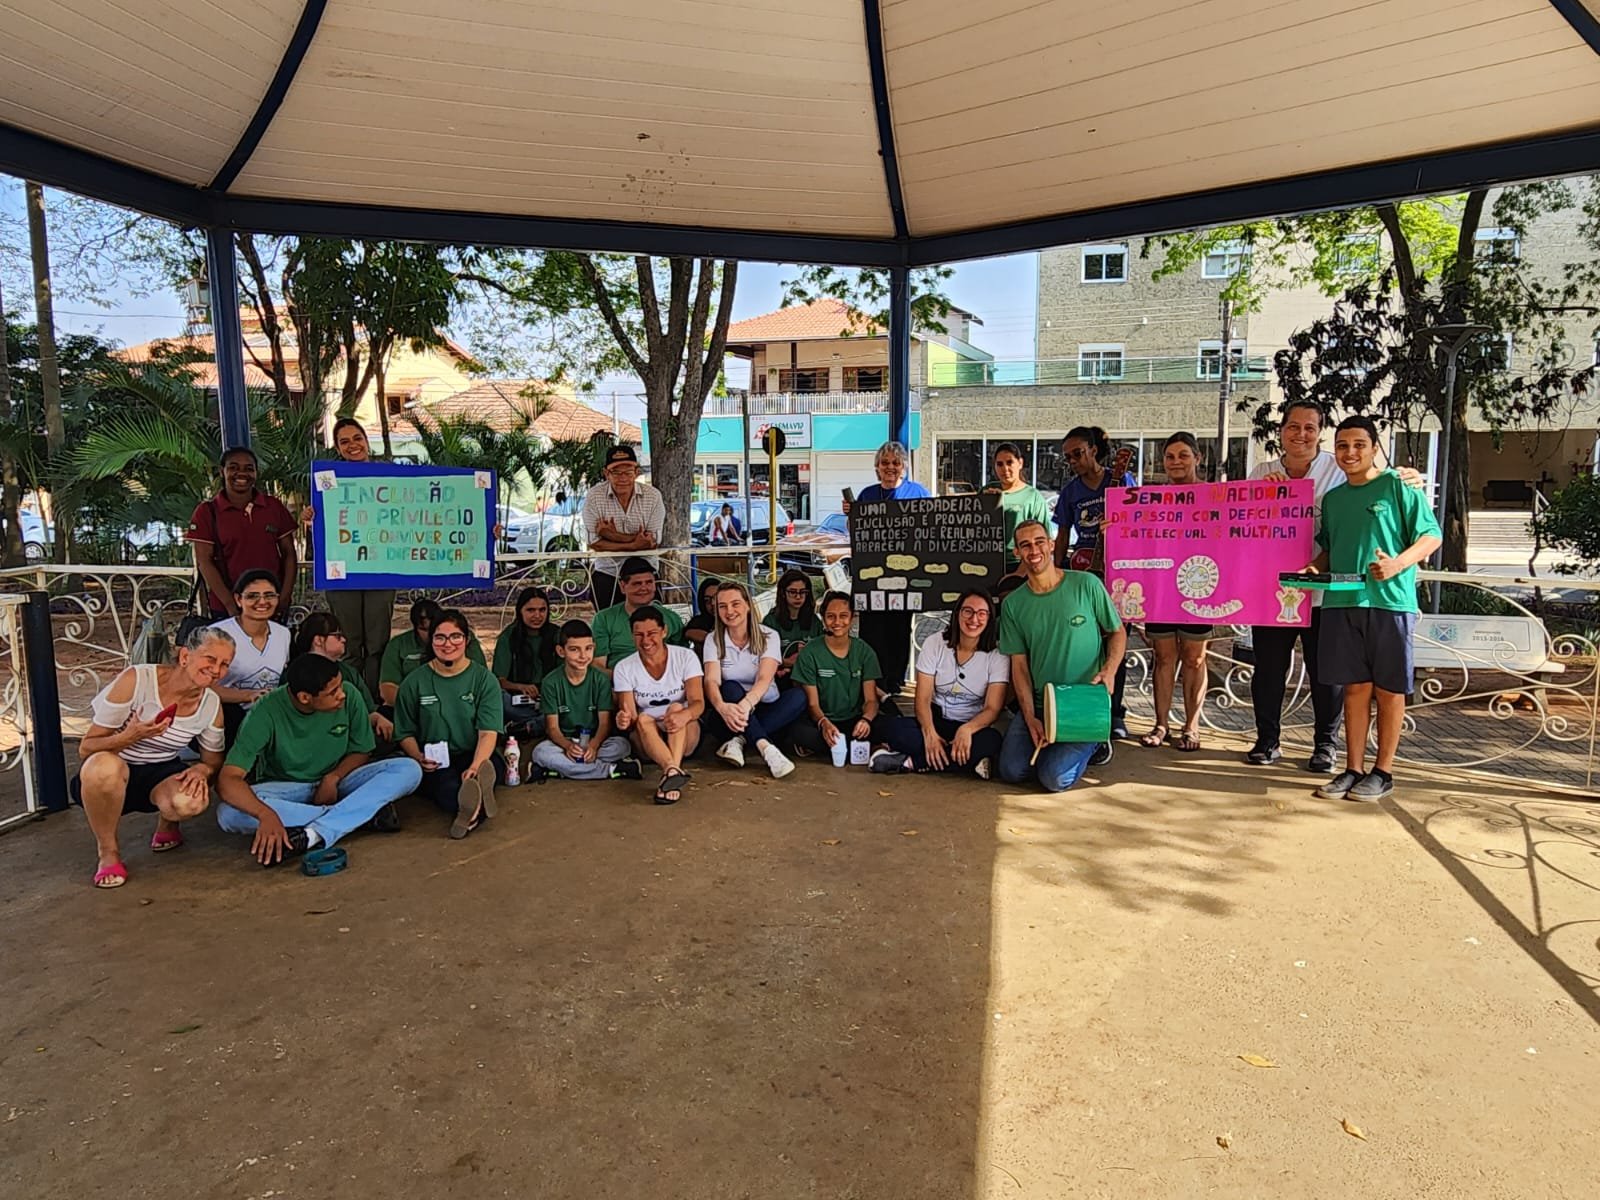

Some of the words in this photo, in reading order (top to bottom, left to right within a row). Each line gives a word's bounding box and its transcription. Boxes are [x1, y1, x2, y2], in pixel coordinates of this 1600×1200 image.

[338, 481, 455, 504] INCLUSÃO
[1122, 487, 1195, 505] SEMANA
[1211, 485, 1299, 503] NACIONAL
[859, 503, 887, 516] UMA
[898, 498, 983, 513] VERDADEIRA
[339, 506, 349, 526] É
[357, 510, 368, 525] O
[855, 514, 916, 531] INCLUSÃO
[921, 512, 929, 526] É
[935, 513, 991, 526] PROVADA
[1111, 511, 1128, 523] DA
[1134, 511, 1183, 522] PESSOA
[1192, 510, 1220, 521] COM
[338, 529, 360, 544] DE
[367, 529, 442, 545] CONVIVER
[449, 530, 479, 545] COM
[855, 531, 870, 542] EM
[914, 527, 936, 540] QUE
[940, 526, 1004, 540] REALMENTE
[357, 546, 378, 561] AS
[855, 541, 905, 553] ABRACEM
[913, 541, 922, 552] A
[928, 539, 1004, 553] DIVERSIDADE
